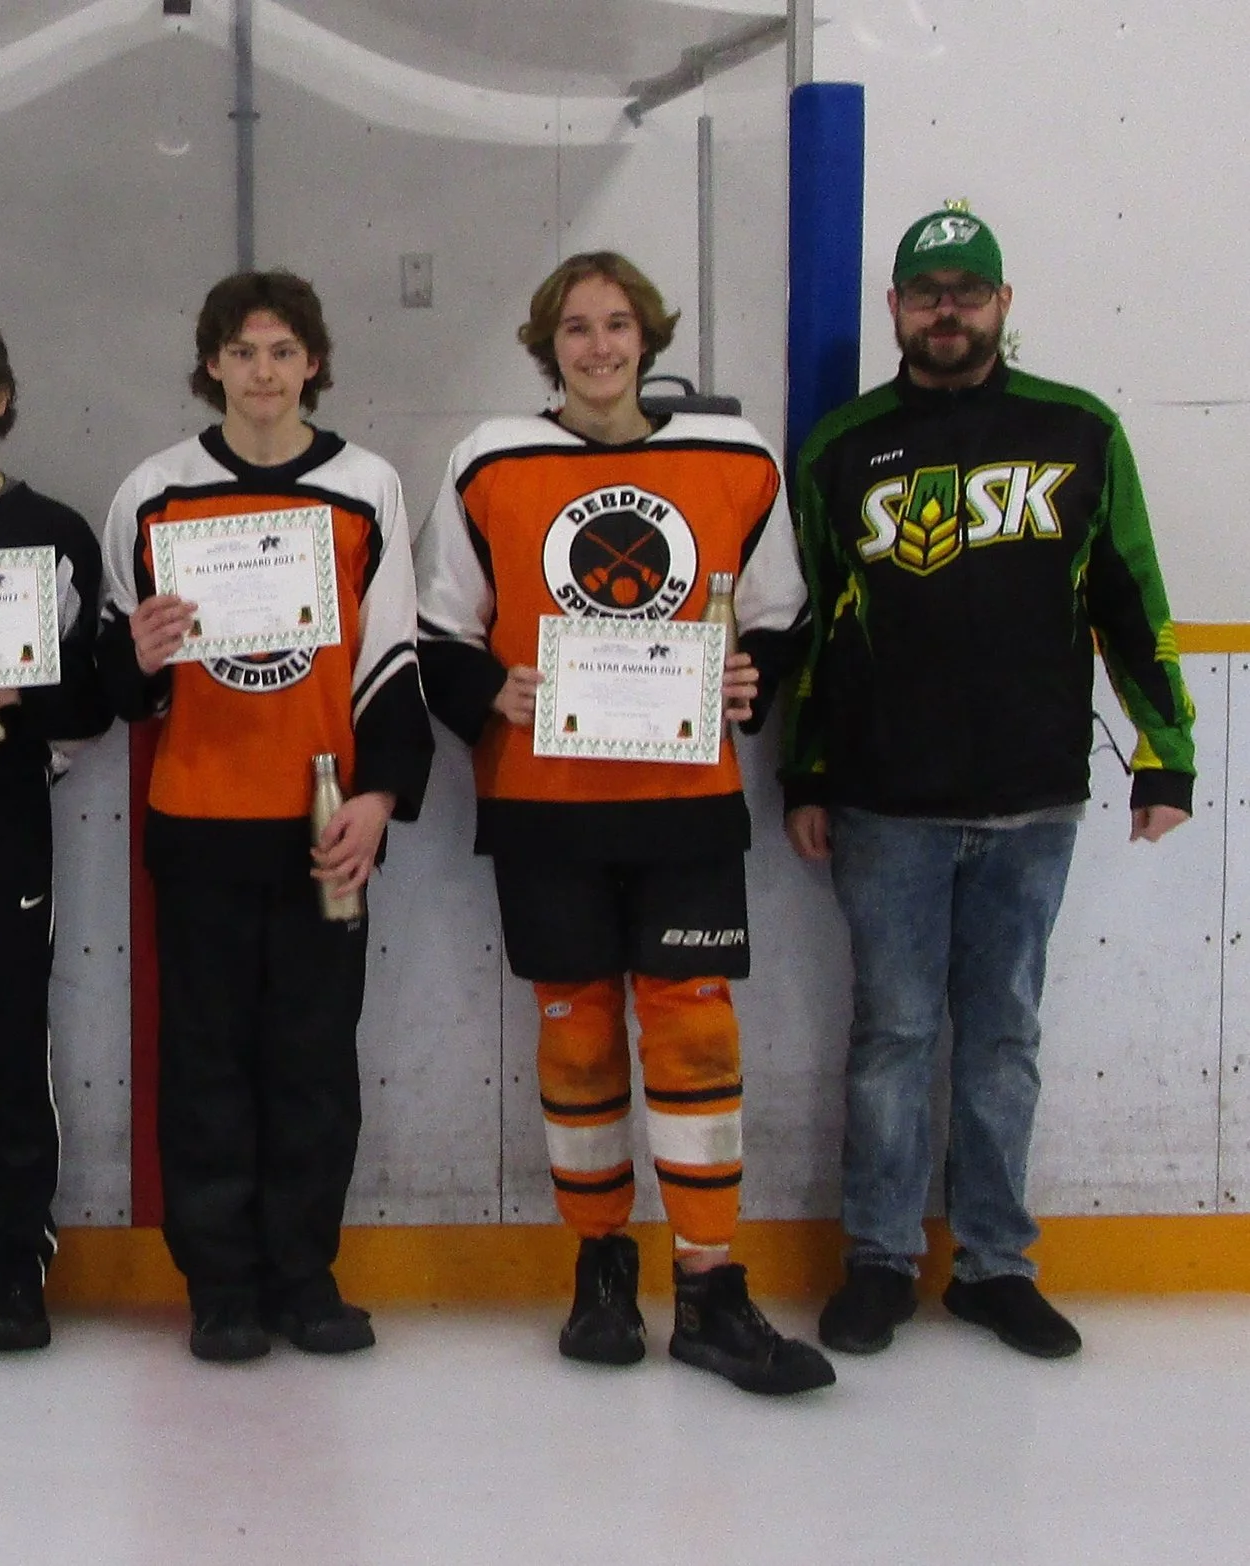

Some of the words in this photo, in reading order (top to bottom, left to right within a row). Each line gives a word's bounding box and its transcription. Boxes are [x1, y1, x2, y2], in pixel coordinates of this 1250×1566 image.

[566, 491, 670, 525] DEBDEN
[196, 564, 210, 575] ALL
[213, 563, 235, 573] STAR
[238, 559, 271, 570] AWARD
[578, 662, 593, 672] ALL
[597, 663, 619, 673] STAR
[622, 664, 657, 674] AWARD
